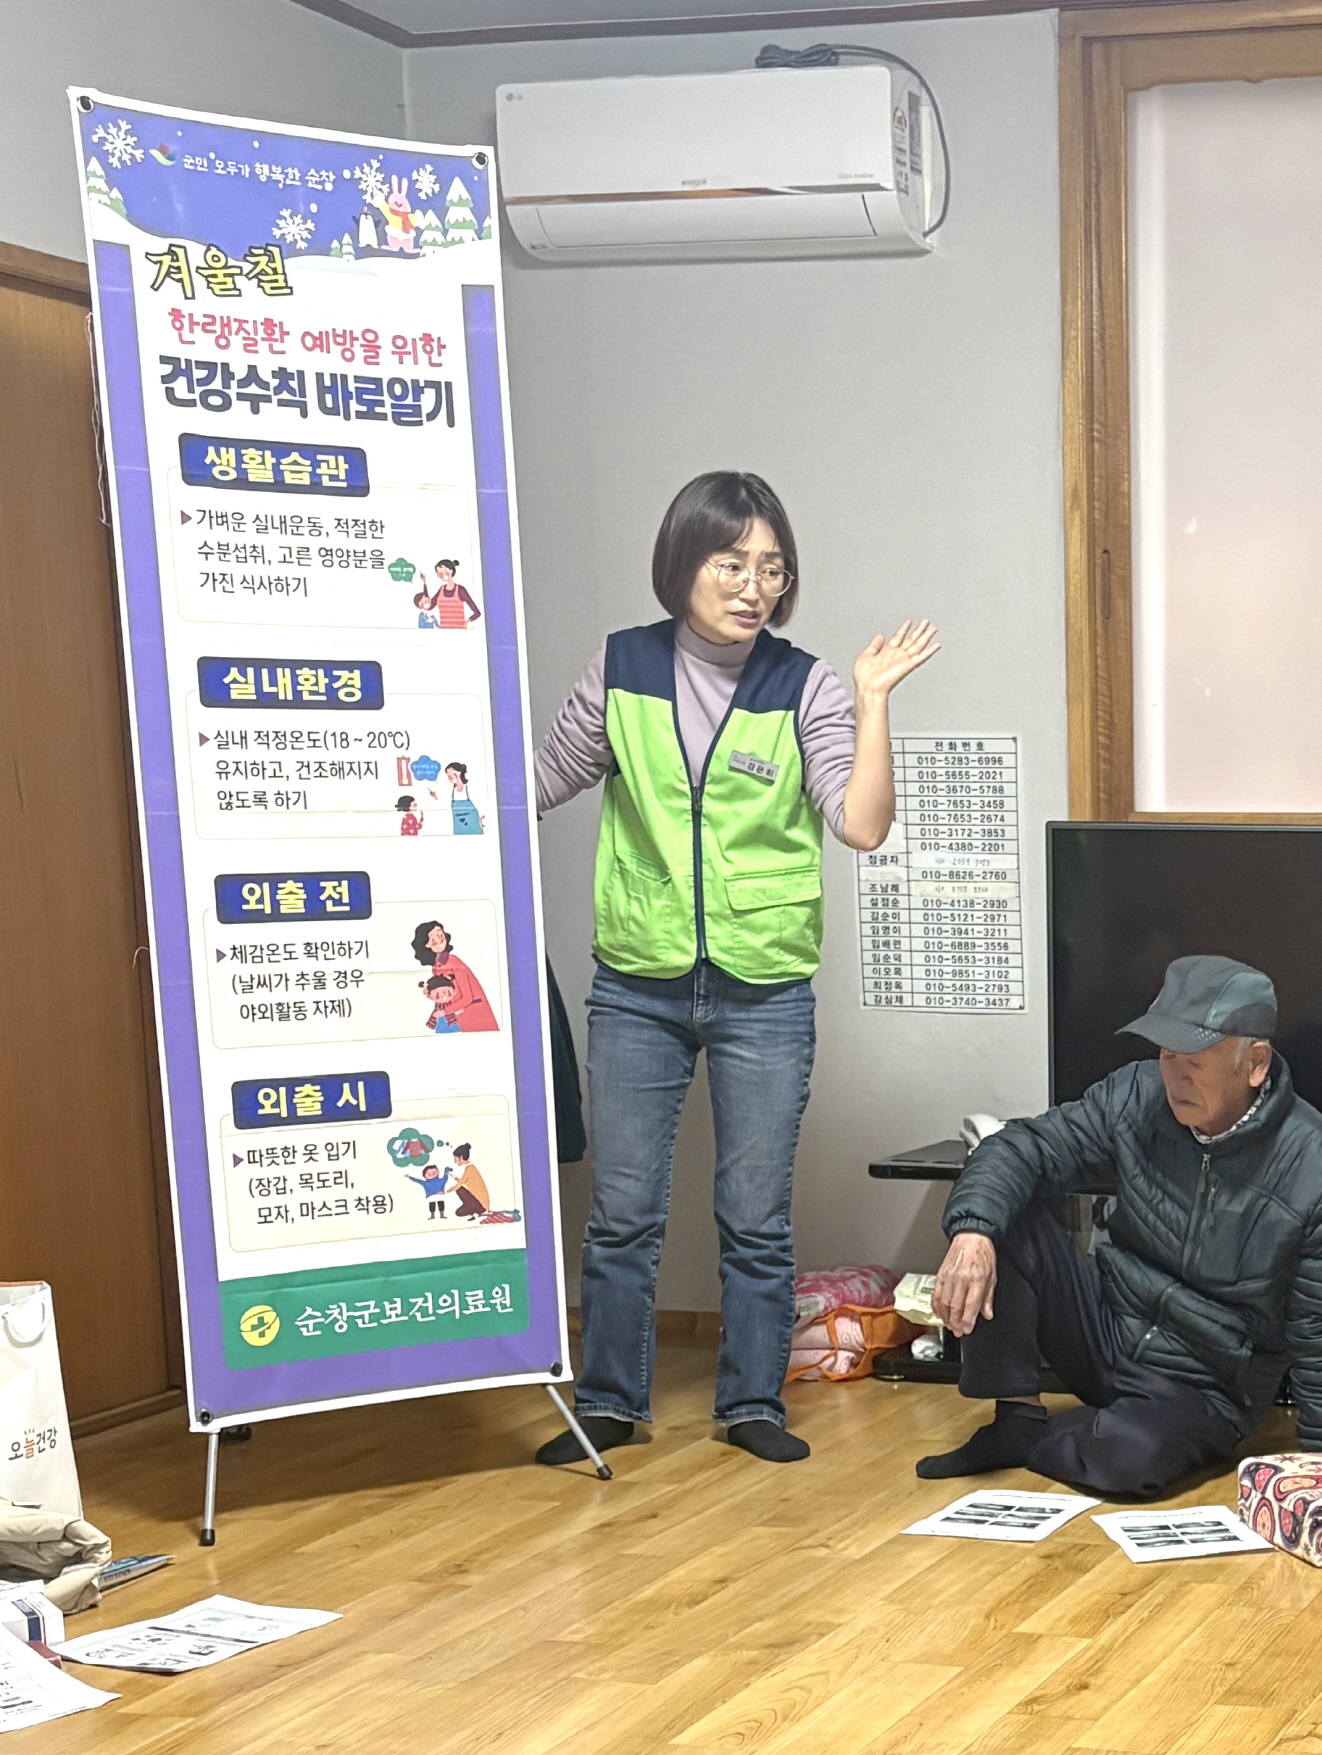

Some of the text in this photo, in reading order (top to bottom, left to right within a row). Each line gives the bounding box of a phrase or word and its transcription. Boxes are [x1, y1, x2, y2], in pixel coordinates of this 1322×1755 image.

[182, 154, 335, 191] 군민 모두가 행복한 순창
[145, 243, 293, 300] 겨울철
[169, 307, 446, 367] 한랭질환 예방을 위한
[160, 355, 455, 428] 건강수칙 바로알기
[204, 445, 348, 488] 생활습관
[196, 509, 385, 539] 가벼운 실내운동, 적절한
[198, 540, 385, 569] 수분섭취, 고른 영양분을
[199, 572, 307, 597] 가진 식사하기
[222, 667, 363, 702] 실내환경
[213, 730, 248, 750] 실내
[215, 760, 378, 781] 유지하고, 건조해지지
[917, 756, 1004, 766] 010-5283-6996
[917, 770, 1004, 780] 010-5655-2021
[217, 790, 307, 811] 않도록 하기
[918, 785, 1005, 794] 010-3670-5788
[918, 799, 1005, 809] 010-7653-3458
[919, 813, 1005, 823] 010-7653-2674
[920, 828, 1006, 837] 010-3172-3853
[920, 842, 1006, 851] 010-4380-2201
[921, 871, 1007, 881] 010-8626-2760
[241, 880, 351, 916] 외출 전
[922, 898, 1008, 908] 010-4138-2930
[923, 912, 1007, 923] 010-5121-2971
[923, 926, 1008, 937] 010-3941-3211
[230, 940, 369, 964] 체감온도 확인하기
[232, 969, 365, 995] (날씨가 추울 경우
[240, 998, 351, 1022] 야외활동 자제)
[925, 996, 1010, 1007] 010-3740-3437
[257, 1082, 367, 1119] 외출 시
[247, 1140, 356, 1168] 따뜻한 옷 입기
[249, 1169, 354, 1198] (장갑, 목도리,
[257, 1193, 393, 1224] 모자, 마스크 착용)
[295, 1283, 513, 1336] 순창군보건의료원
[8, 1426, 58, 1460] 오늘건강
